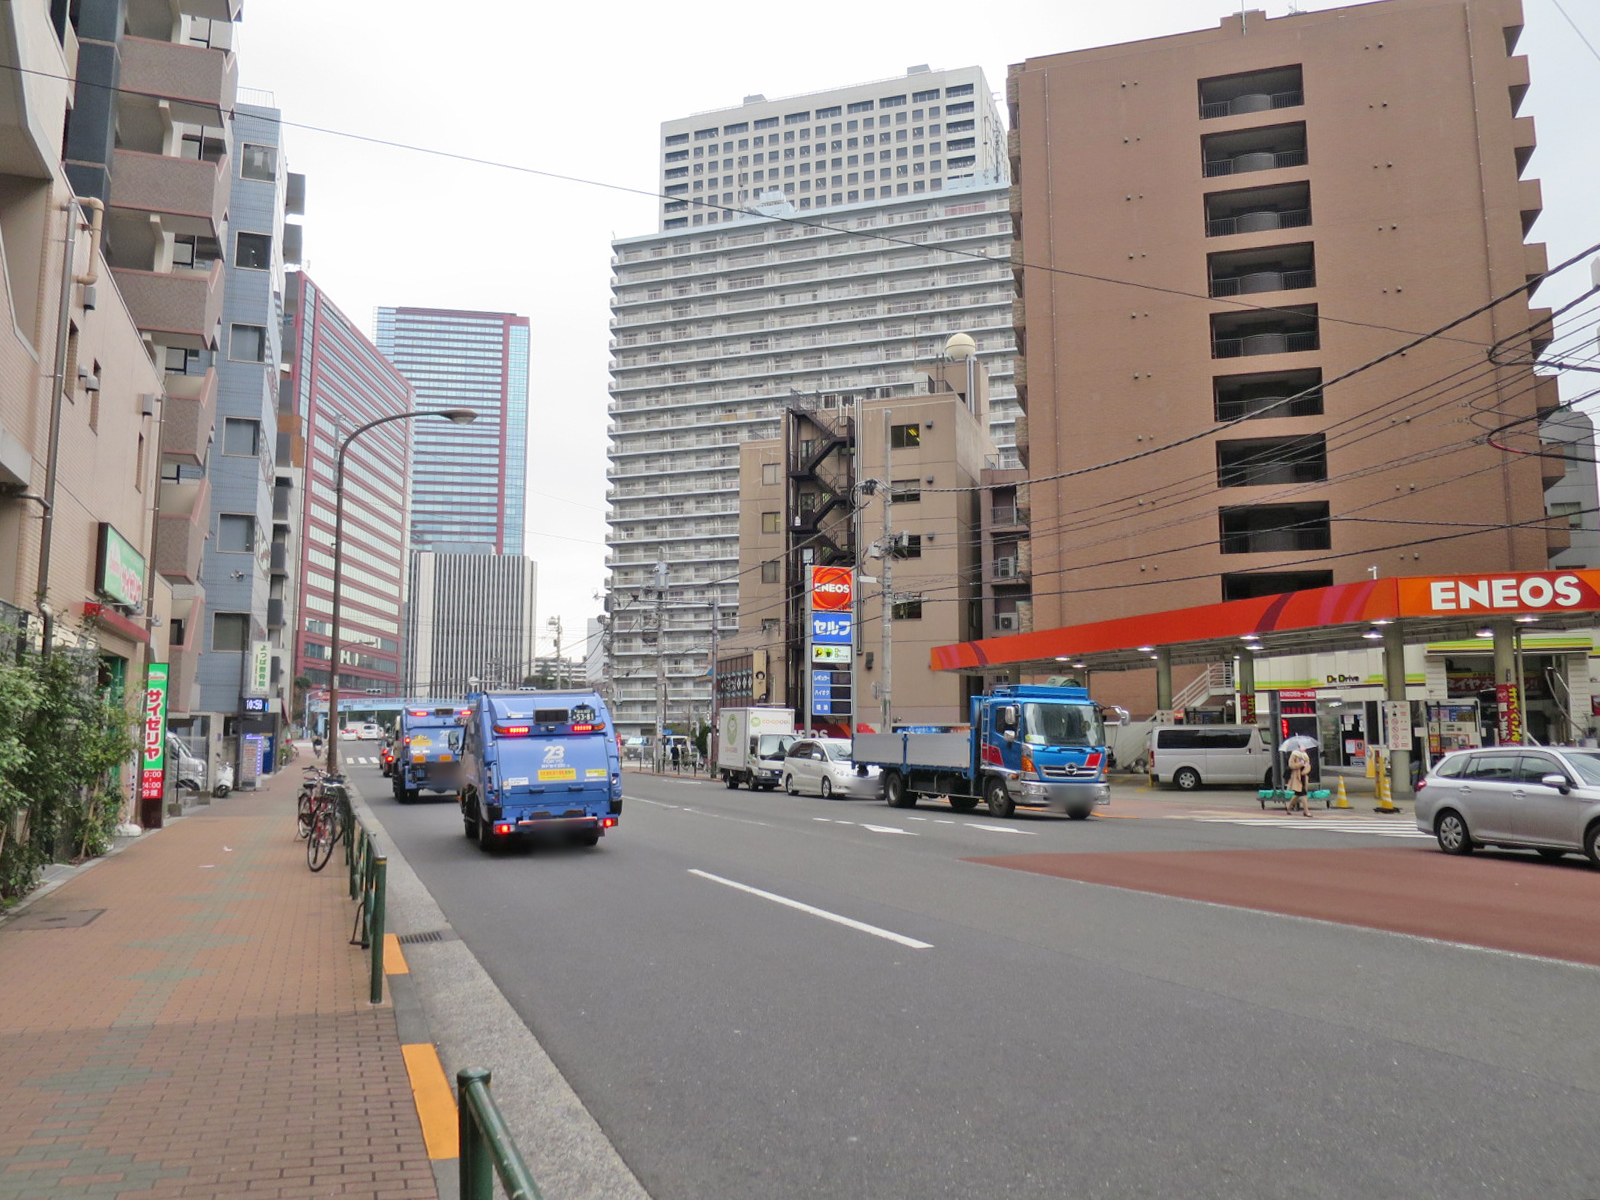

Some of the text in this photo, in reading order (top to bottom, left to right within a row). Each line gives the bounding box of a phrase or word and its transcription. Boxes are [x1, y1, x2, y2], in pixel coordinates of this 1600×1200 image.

[814, 582, 850, 594] ENEOS
[1430, 575, 1582, 611] ENEOS
[814, 619, 851, 636] セルフ
[1338, 674, 1359, 683] Drive
[145, 689, 162, 761] サイゼリヤ
[543, 745, 565, 759] 23
